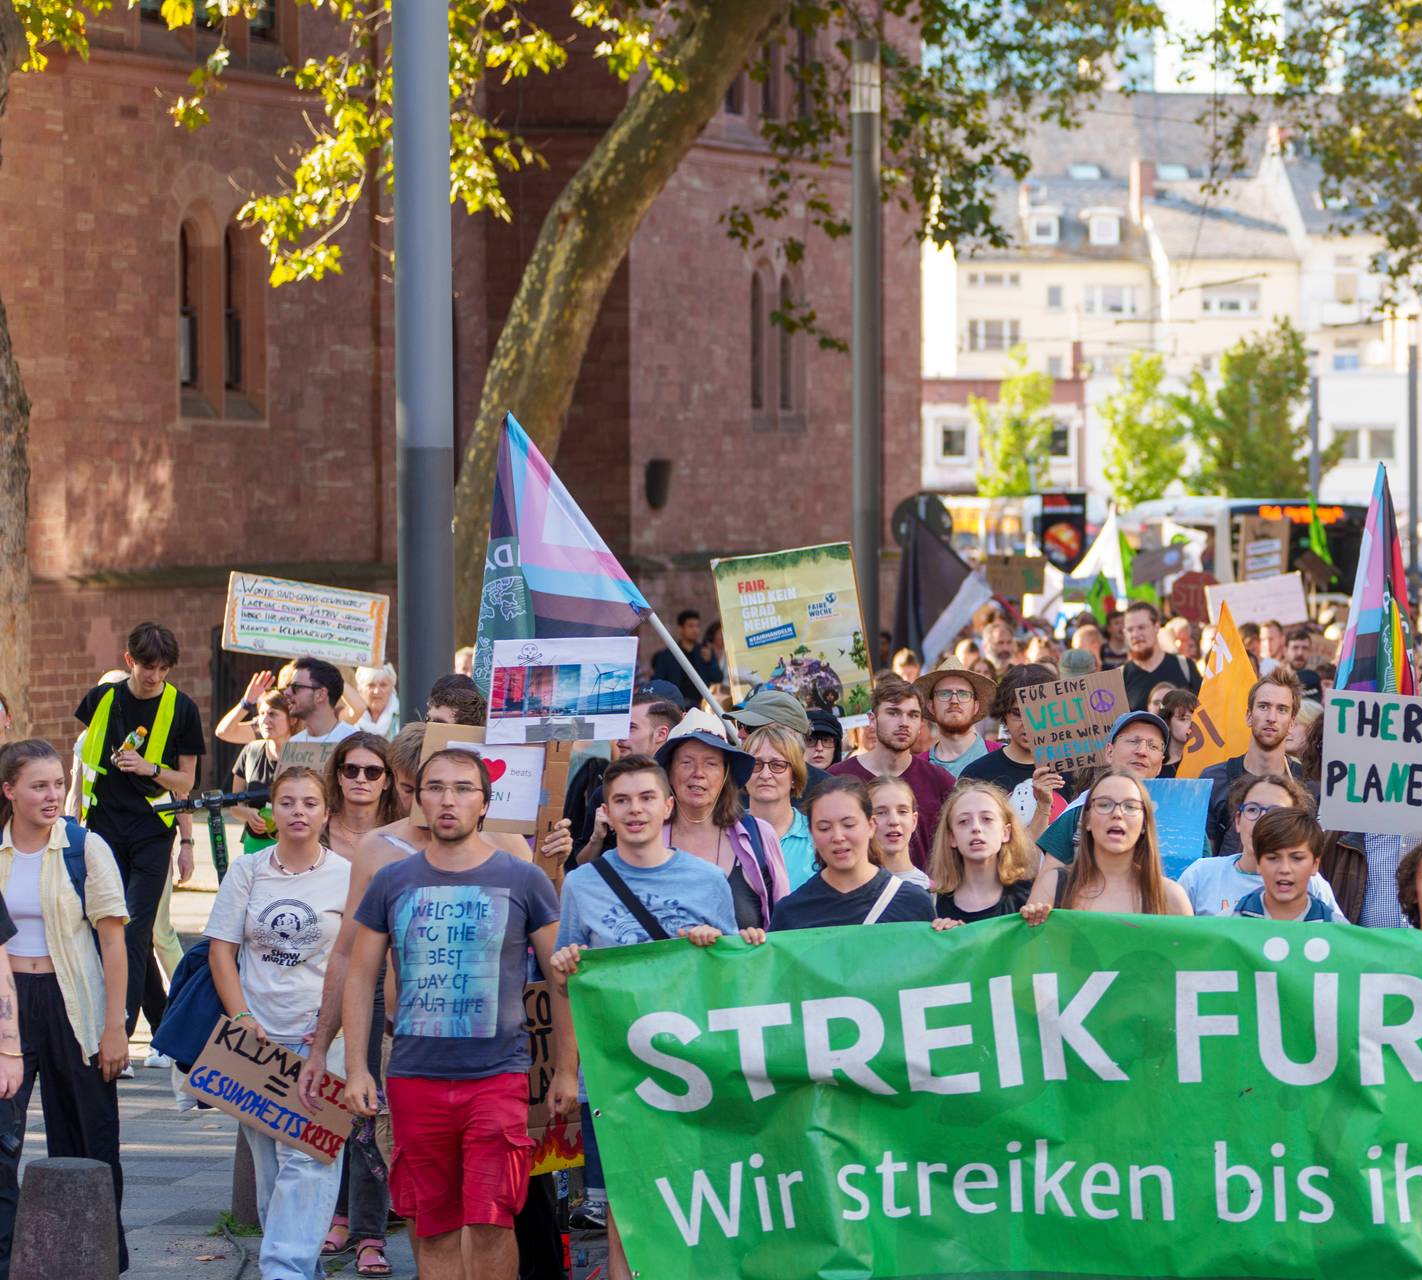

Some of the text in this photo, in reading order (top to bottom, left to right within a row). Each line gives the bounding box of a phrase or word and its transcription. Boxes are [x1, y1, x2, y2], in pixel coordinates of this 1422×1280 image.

[737, 578, 770, 594] FAIR.
[740, 587, 797, 607] UND KEIN
[807, 602, 827, 611] FAIRE
[742, 603, 776, 620] GRAD
[808, 607, 833, 617] WOCHE
[743, 615, 782, 632] MEHR!
[1018, 679, 1087, 704] FÜR EINE
[1025, 697, 1085, 732] WELT
[1033, 736, 1045, 746] IN
[1050, 730, 1072, 742] DER
[1076, 724, 1100, 738] WIR
[510, 768, 532, 777] beats
[411, 901, 489, 920] WELCOME
[417, 923, 477, 944] TO THE
[271, 949, 301, 960] SHOW
[428, 948, 463, 970] BEST
[417, 973, 448, 990] DAY
[452, 997, 484, 1020] LIFE
[627, 970, 1130, 1113] STREIK
[189, 1065, 346, 1159] GESUNDHEITSKRISE
[655, 1152, 804, 1248] Wir
[837, 1138, 1175, 1221] streiken
[1214, 1140, 1335, 1225] bis
